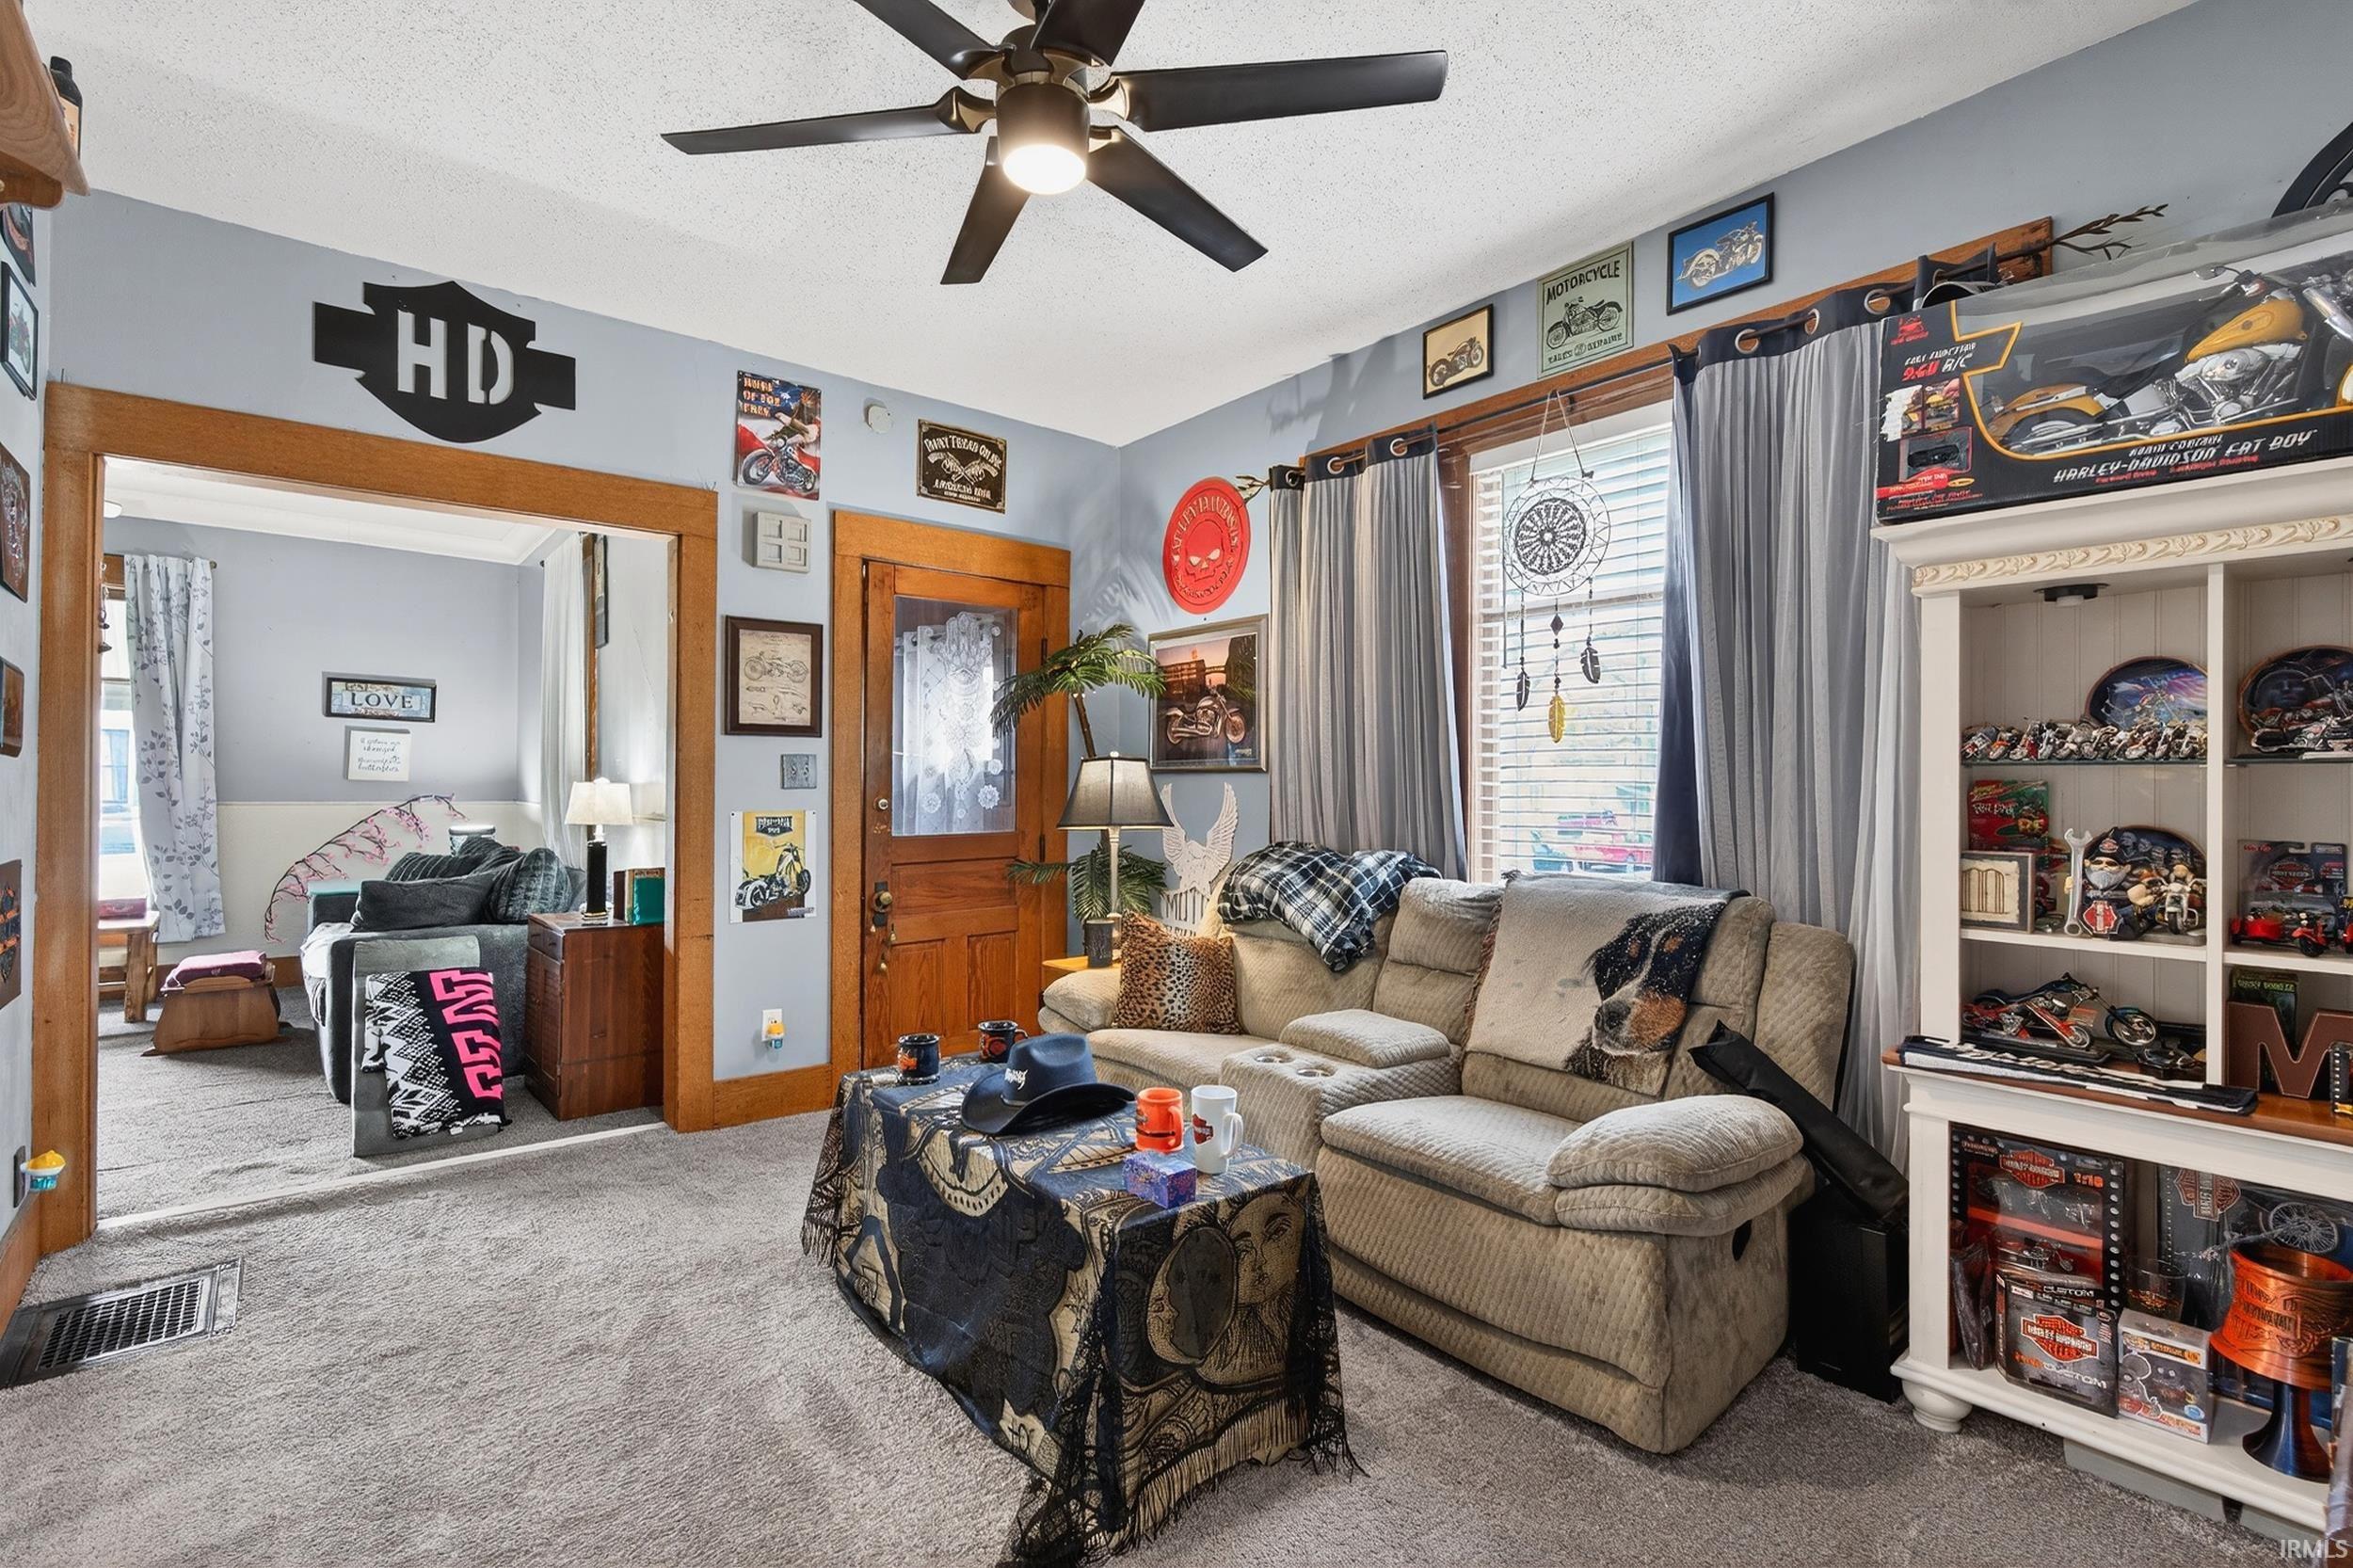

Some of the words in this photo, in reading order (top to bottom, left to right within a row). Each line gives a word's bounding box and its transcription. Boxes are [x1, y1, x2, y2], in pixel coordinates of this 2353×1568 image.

[1545, 260, 1621, 306] MOTORCYCLE
[396, 307, 515, 406] HD
[1942, 352, 1975, 374] R/C
[949, 434, 979, 454] TREAD
[2053, 446, 2219, 483] HARLEY-DAVIDSON
[2225, 437, 2267, 456] FAT
[2268, 430, 2313, 451] BOY
[351, 693, 413, 709] LOVE
[2043, 1286, 2094, 1298] CUSTOM
[2041, 1361, 2107, 1389] CUSTOM
